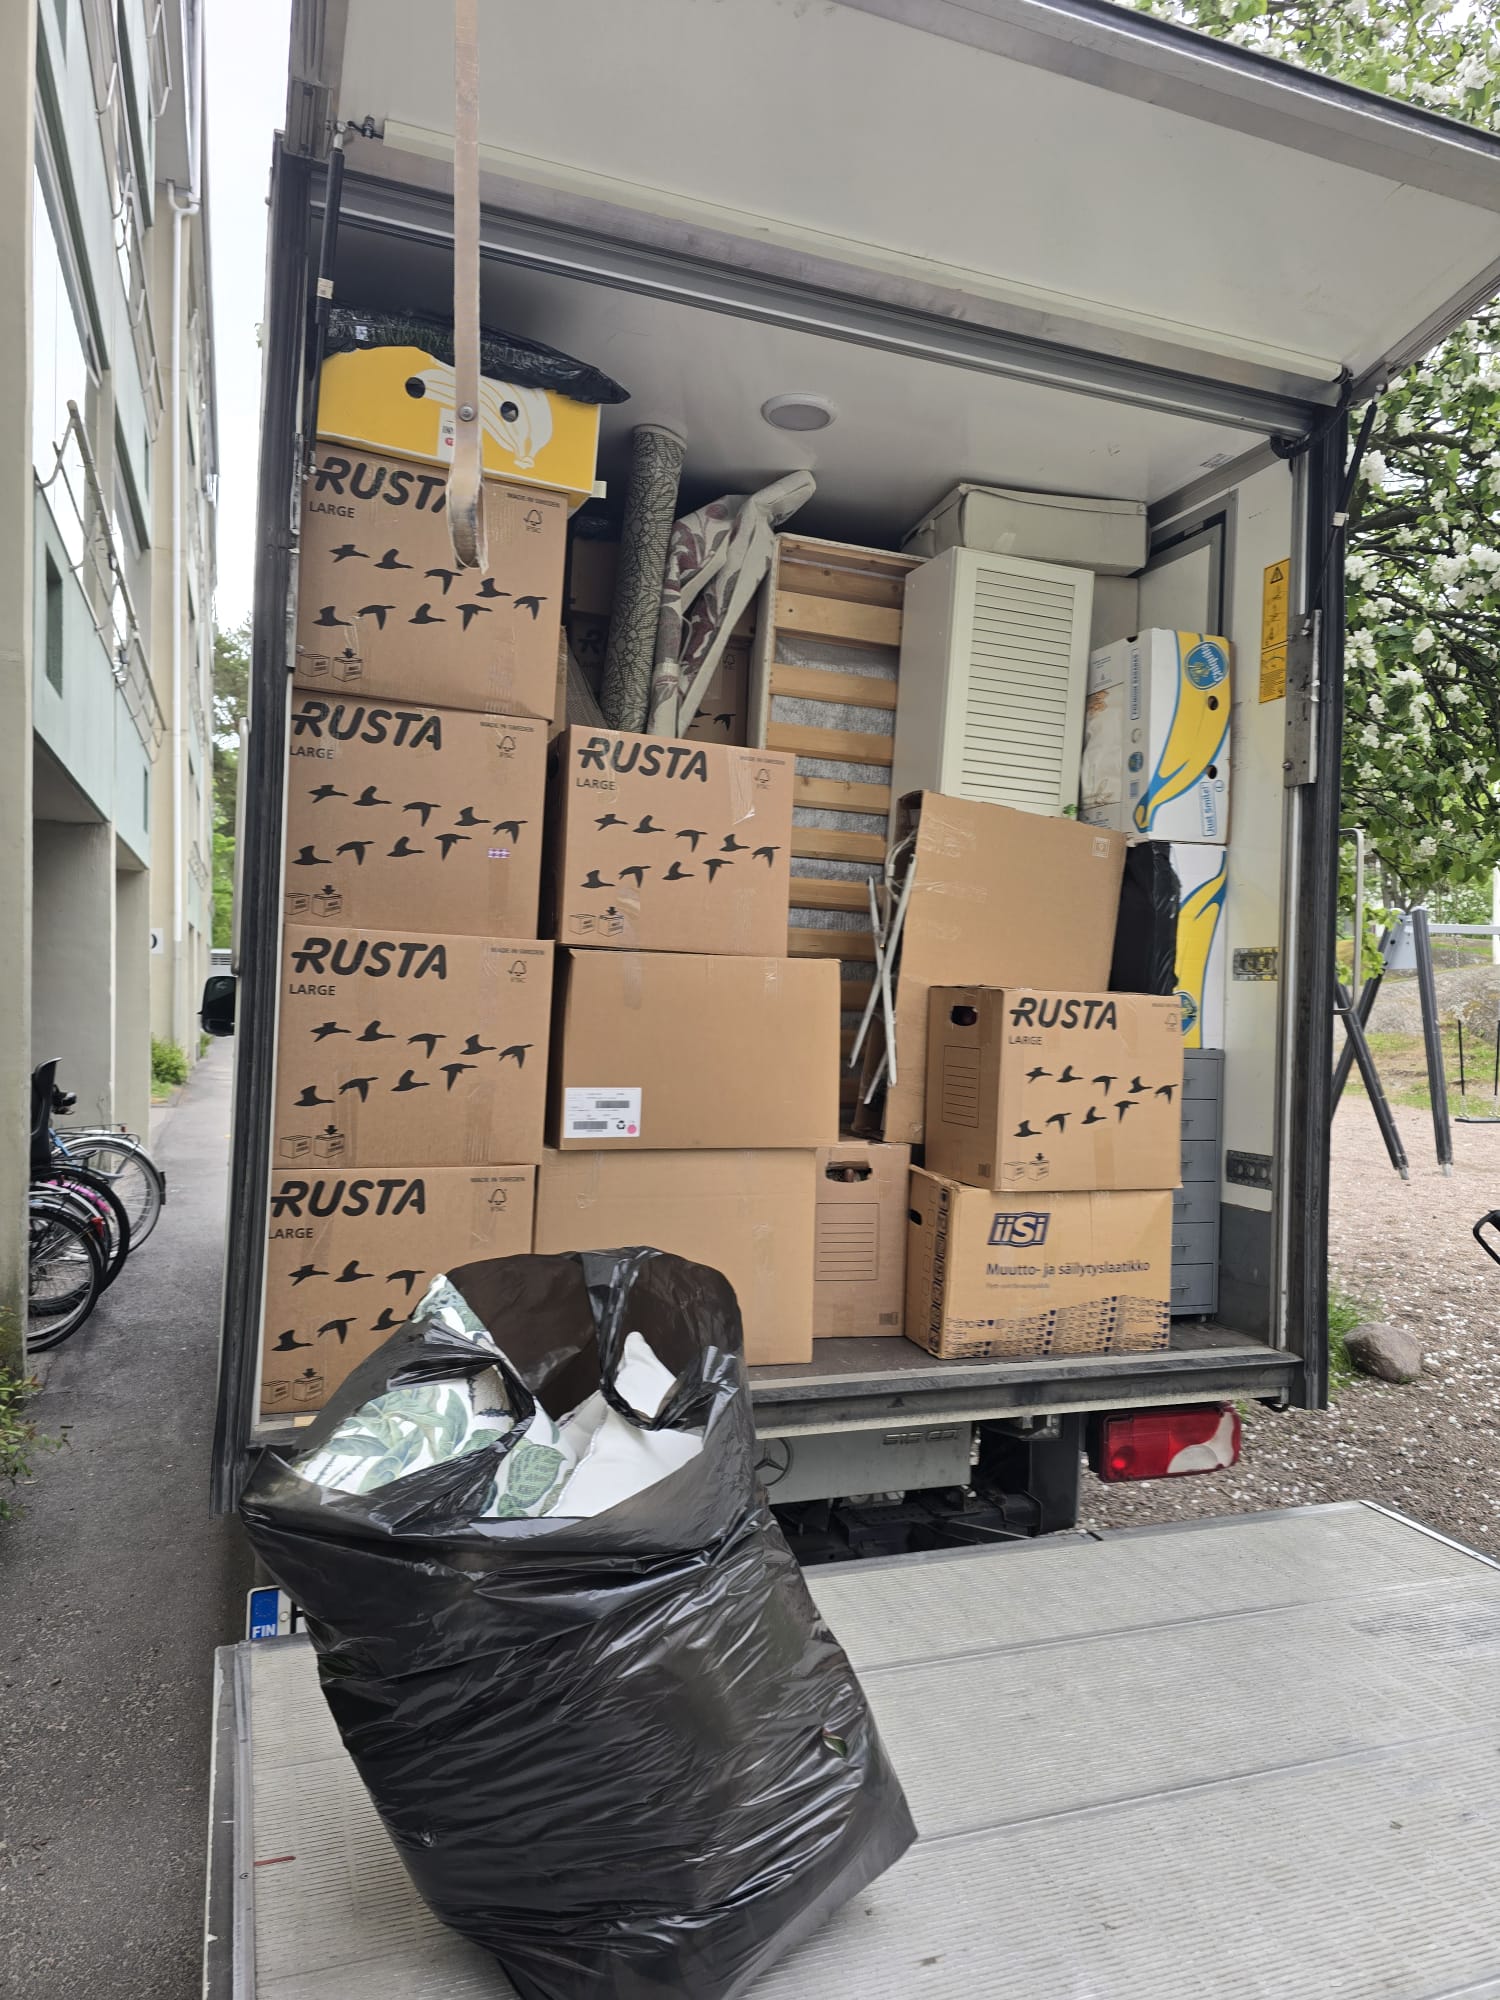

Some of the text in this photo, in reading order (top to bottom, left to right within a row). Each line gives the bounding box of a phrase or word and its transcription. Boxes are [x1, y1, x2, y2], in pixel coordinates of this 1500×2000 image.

[309, 501, 355, 518] LARGE
[291, 701, 442, 750] RUSTA
[290, 746, 334, 759] LARGE
[577, 737, 708, 782] RUSTA
[576, 778, 616, 791] LARGE
[291, 937, 447, 980] RUSTA
[289, 984, 336, 996] LARGE
[1009, 997, 1117, 1030] RUSTA
[1008, 1035, 1043, 1046] LARGE
[270, 1179, 426, 1217] RUSTA
[986, 1260, 1151, 1278] Muutto- ja säilytyslaatikko
[252, 1623, 276, 1639] FIN
